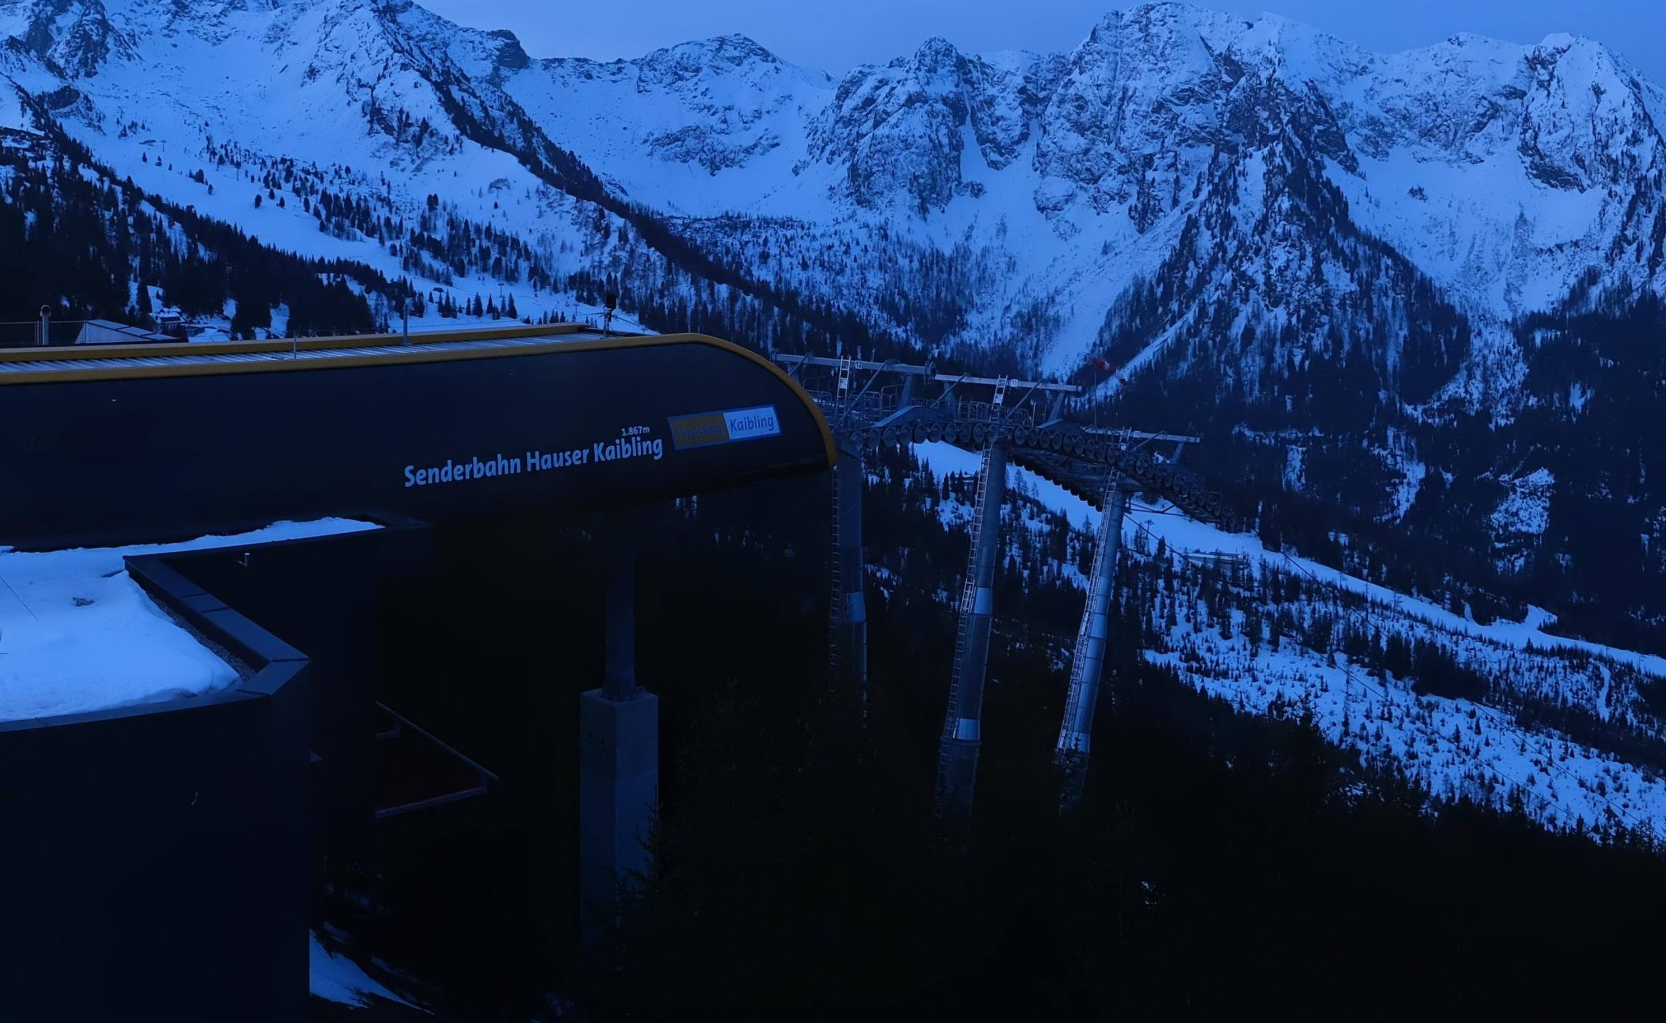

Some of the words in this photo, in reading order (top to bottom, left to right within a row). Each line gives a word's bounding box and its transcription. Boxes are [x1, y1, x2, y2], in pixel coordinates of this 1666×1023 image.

[621, 425, 651, 437] 1.867m
[730, 415, 775, 432] Kaibling
[404, 454, 521, 488] Senderbahn
[526, 448, 590, 472] Hauser
[593, 435, 663, 461] Kaibling
